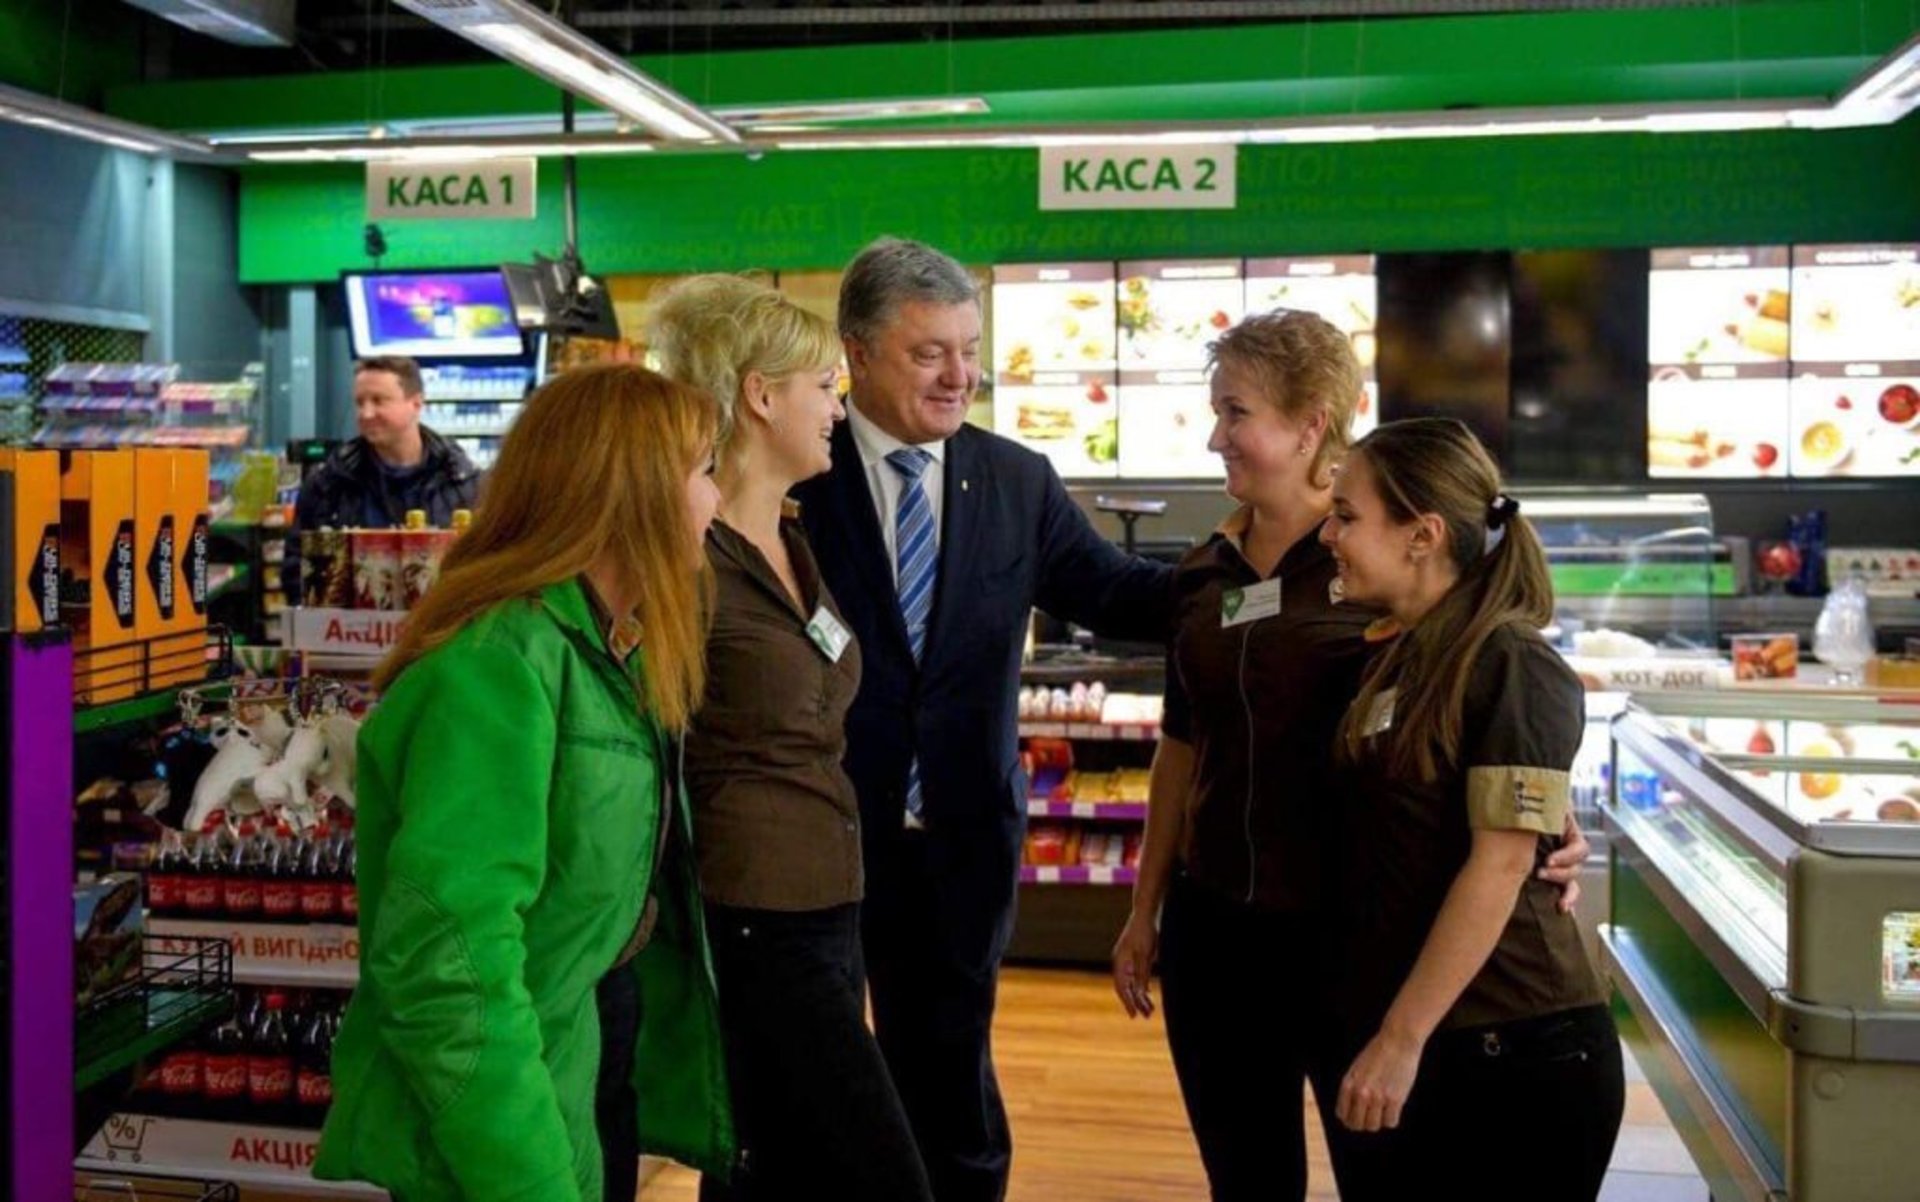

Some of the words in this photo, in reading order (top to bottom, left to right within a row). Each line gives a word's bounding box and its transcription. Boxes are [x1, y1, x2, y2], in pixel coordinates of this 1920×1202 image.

[388, 174, 488, 206] КАСА
[499, 175, 512, 205] 1
[1063, 157, 1180, 192] КАСА
[1194, 158, 1217, 191] 2
[1610, 669, 1706, 690] ХОТ-ДОГ
